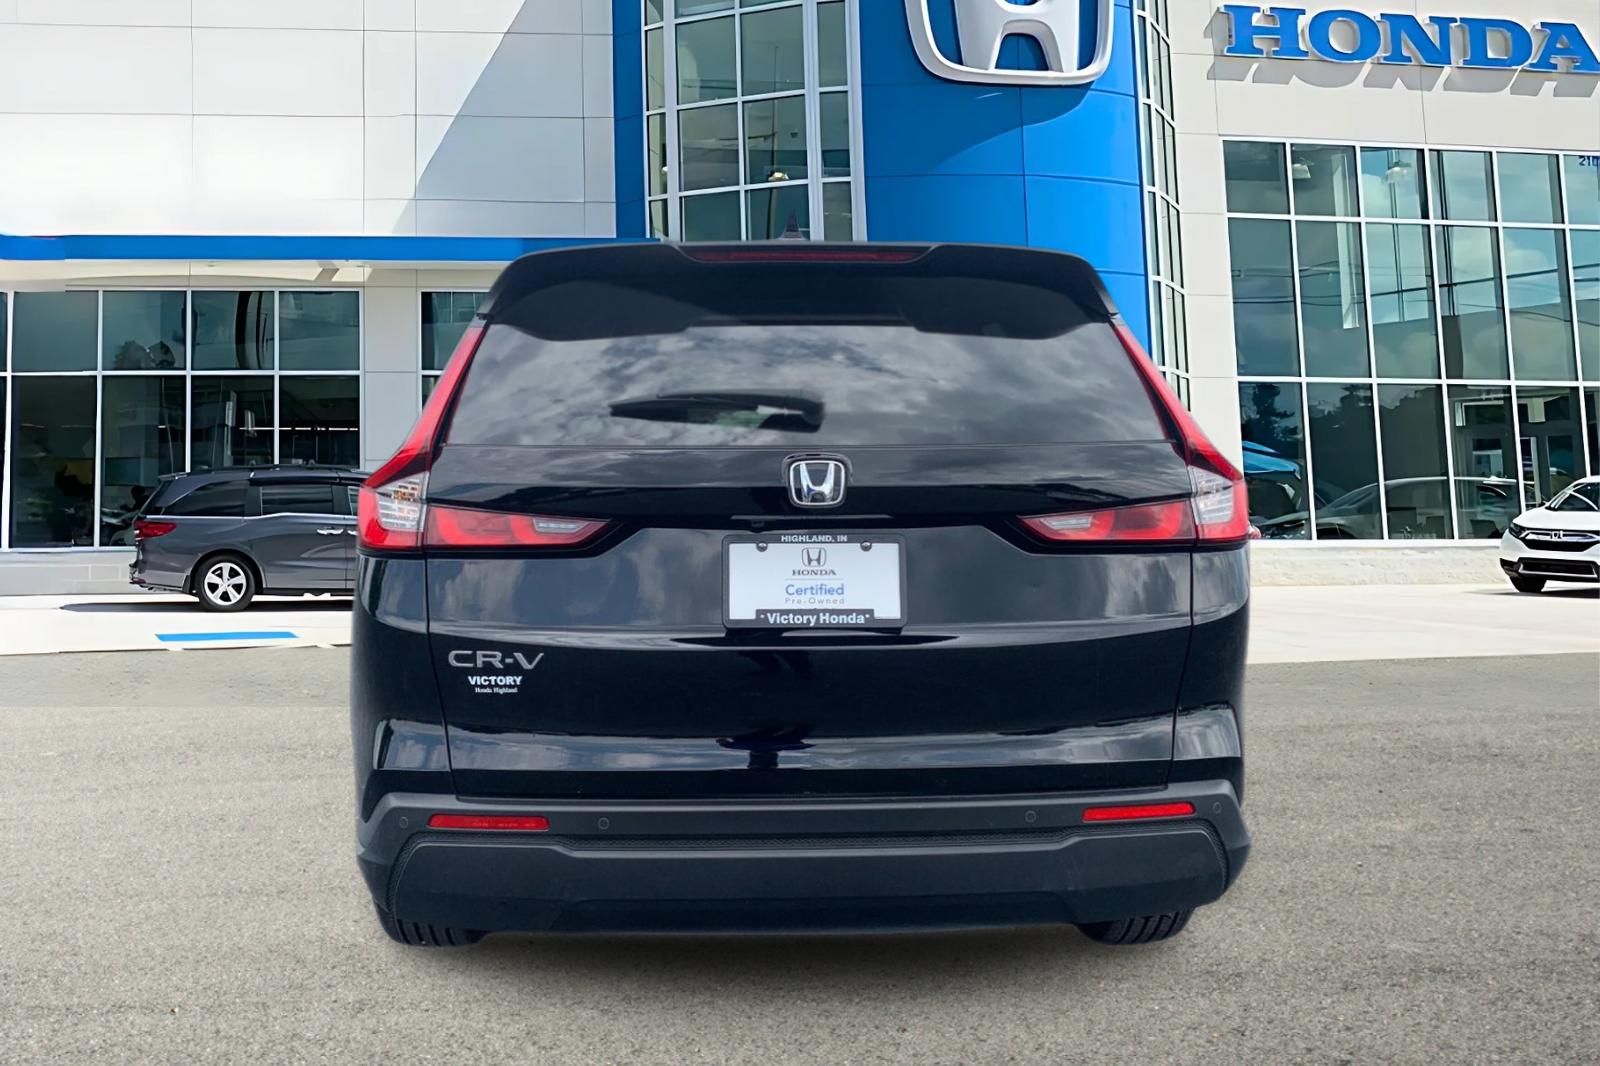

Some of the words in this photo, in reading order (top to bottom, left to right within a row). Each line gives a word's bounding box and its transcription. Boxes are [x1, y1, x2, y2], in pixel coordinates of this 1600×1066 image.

[1223, 4, 1600, 74] HONDA
[785, 584, 845, 596] Certified
[785, 597, 845, 605] Pre-Owned
[767, 612, 817, 626] Victory
[819, 612, 865, 624] Honda
[448, 650, 544, 670] CR-V
[467, 675, 523, 686] VICTORY
